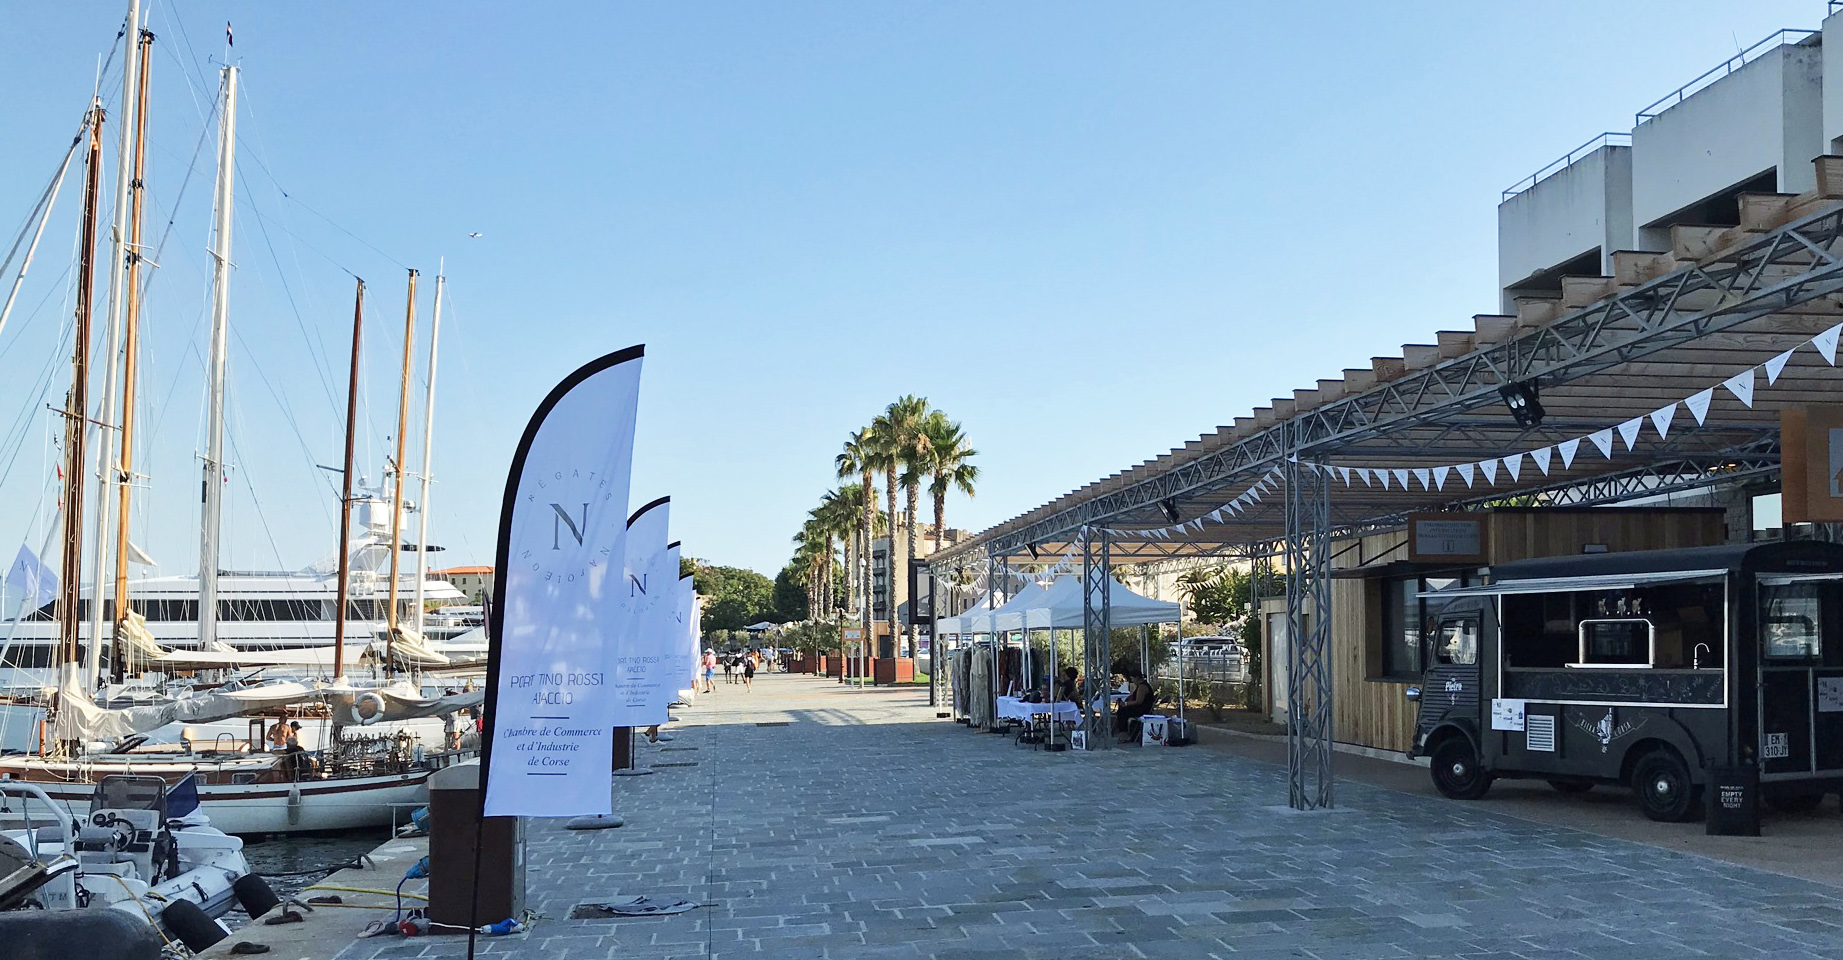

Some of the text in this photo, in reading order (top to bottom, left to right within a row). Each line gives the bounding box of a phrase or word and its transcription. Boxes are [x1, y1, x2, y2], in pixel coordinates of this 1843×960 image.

[549, 503, 590, 550] N
[629, 573, 648, 597] N
[510, 673, 604, 688] PORT TINO ROSSI
[531, 691, 574, 705] AJACCIO
[539, 726, 552, 736] de
[553, 726, 602, 737] Commerce
[516, 743, 525, 751] et
[527, 756, 570, 766] de Corse
